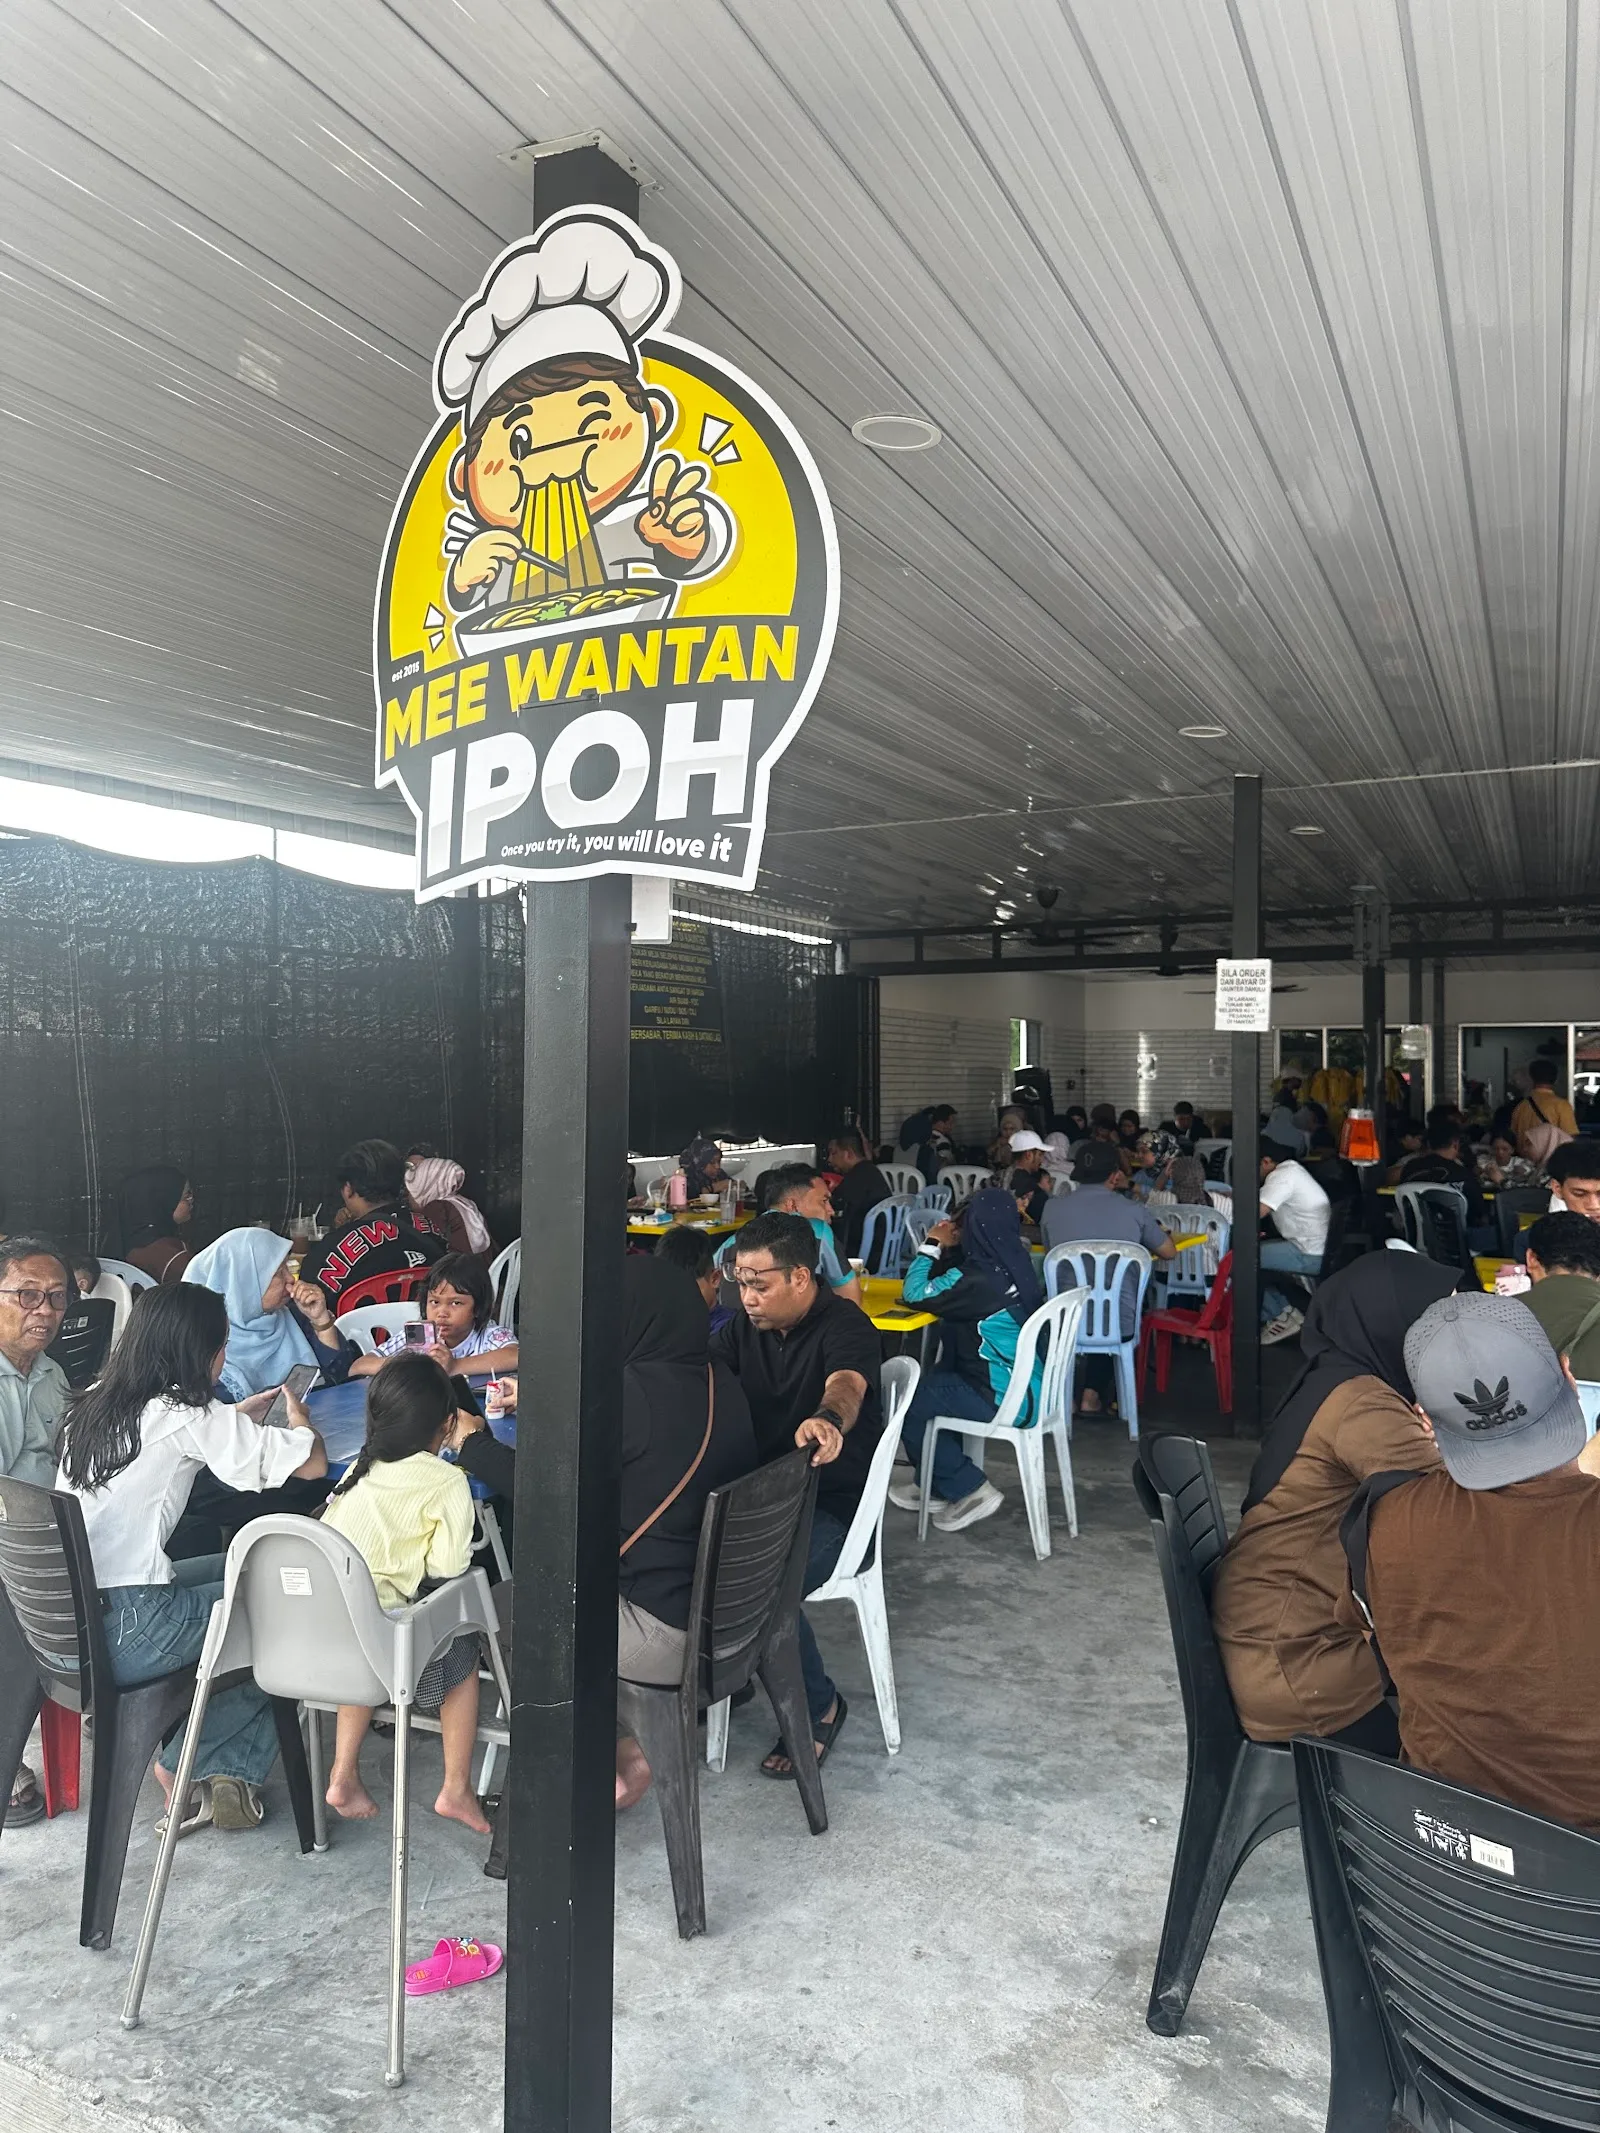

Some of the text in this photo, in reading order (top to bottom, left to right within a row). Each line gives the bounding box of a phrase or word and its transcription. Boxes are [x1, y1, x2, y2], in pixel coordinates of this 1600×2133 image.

[391, 661, 420, 682] est 2015
[384, 624, 799, 761] MEE WANTAN
[426, 698, 754, 878] IPOH
[501, 829, 733, 863] Once you try it, you will love it
[1221, 969, 1266, 978] SILA ORDER
[317, 1219, 399, 1293] NEW
[1465, 1403, 1528, 1431] adidas
